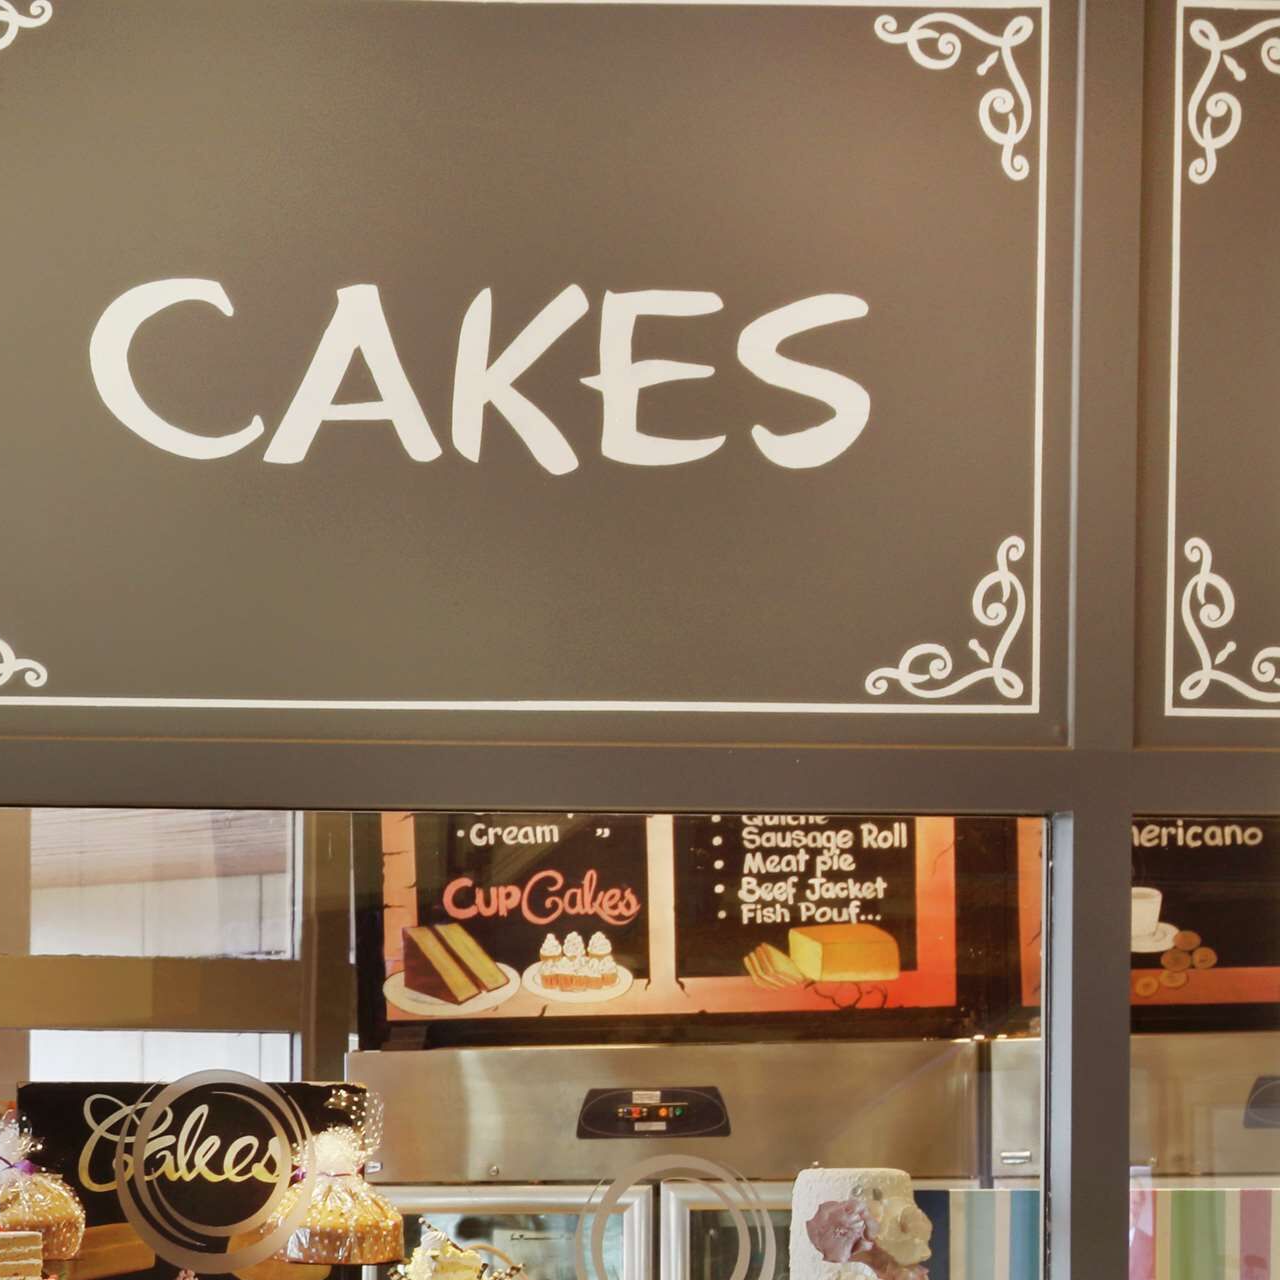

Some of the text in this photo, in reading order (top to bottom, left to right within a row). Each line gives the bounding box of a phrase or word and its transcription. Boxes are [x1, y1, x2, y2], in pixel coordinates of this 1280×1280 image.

[88, 277, 872, 475] CAKES
[469, 823, 560, 847] Cream
[742, 822, 908, 856] Sausage Roll
[743, 849, 857, 878] Meat pie
[738, 876, 888, 905] Beef Jacket
[741, 903, 791, 925] Fish
[78, 1093, 296, 1193] Cakes
